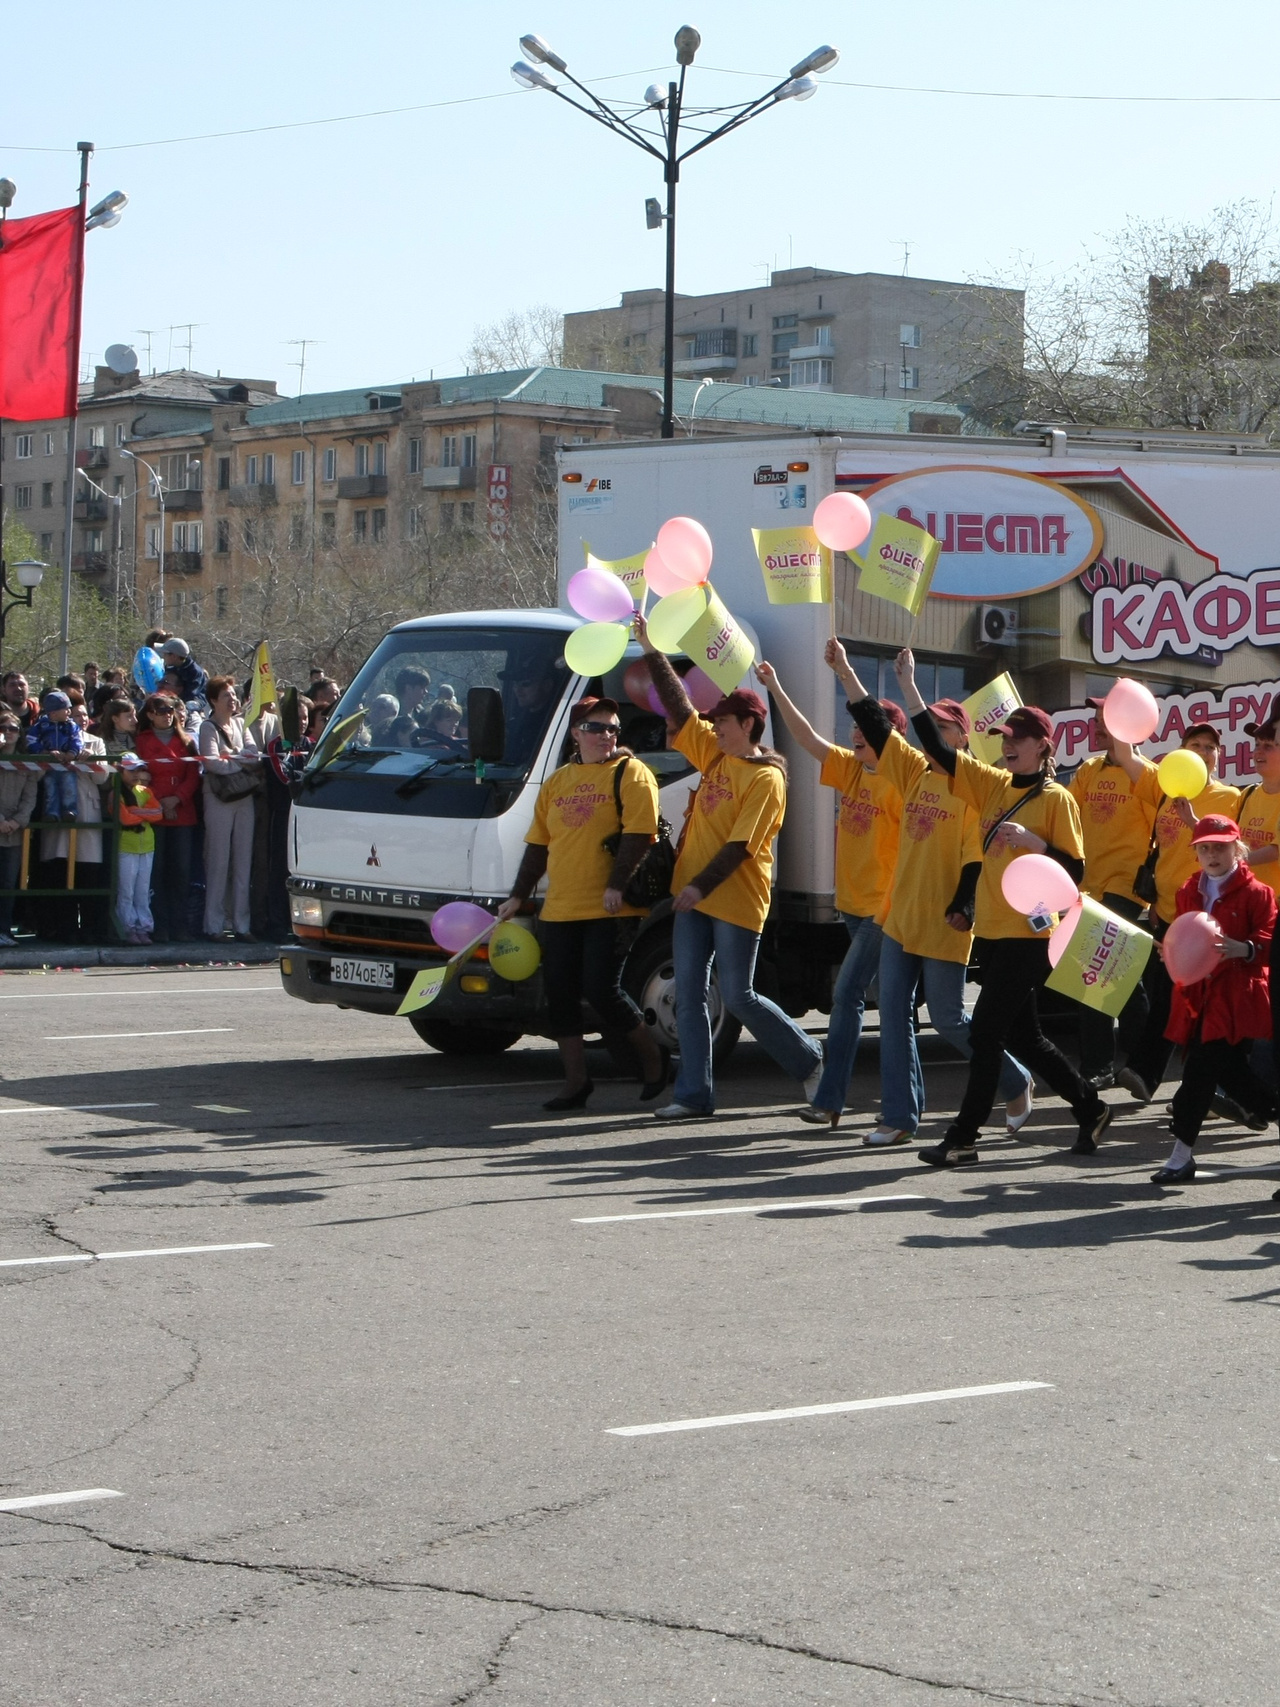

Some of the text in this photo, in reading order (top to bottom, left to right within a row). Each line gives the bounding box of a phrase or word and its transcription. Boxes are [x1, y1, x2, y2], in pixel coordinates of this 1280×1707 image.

[574, 783, 596, 793] ООО
[1097, 780, 1116, 790] ООО
[920, 790, 940, 804] ООО
[330, 886, 422, 907] CANTER
[1082, 920, 1119, 986] ФИЕСТ
[379, 963, 391, 979] 75
